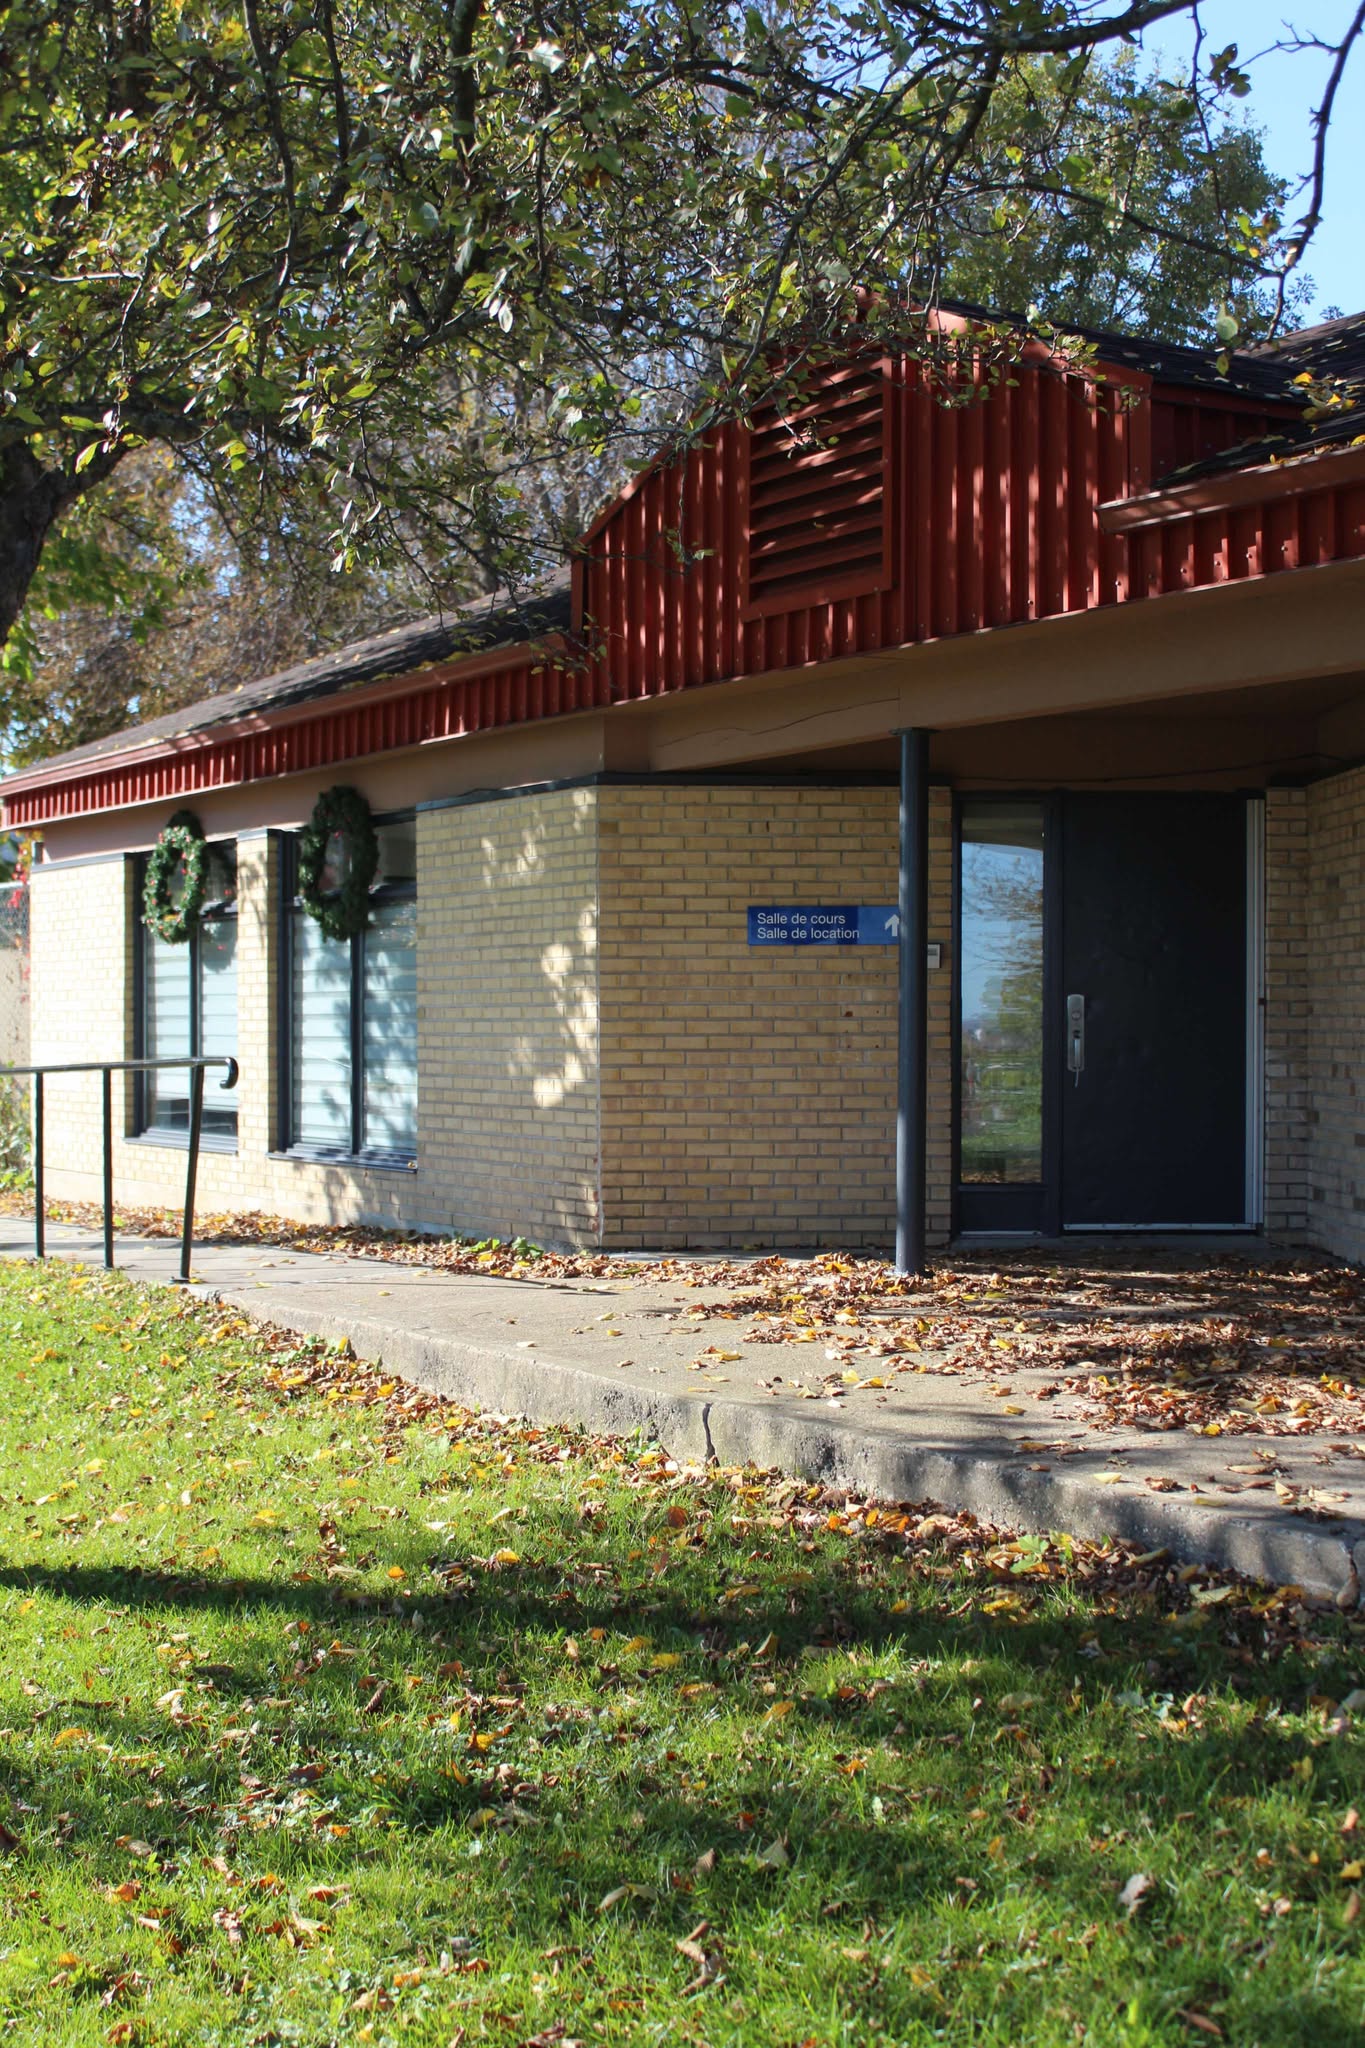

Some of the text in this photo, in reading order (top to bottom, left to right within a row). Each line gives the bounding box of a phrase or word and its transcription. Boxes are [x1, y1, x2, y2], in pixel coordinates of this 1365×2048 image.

[757, 912, 846, 925] Salle de cours
[757, 927, 860, 939] Salle de location
